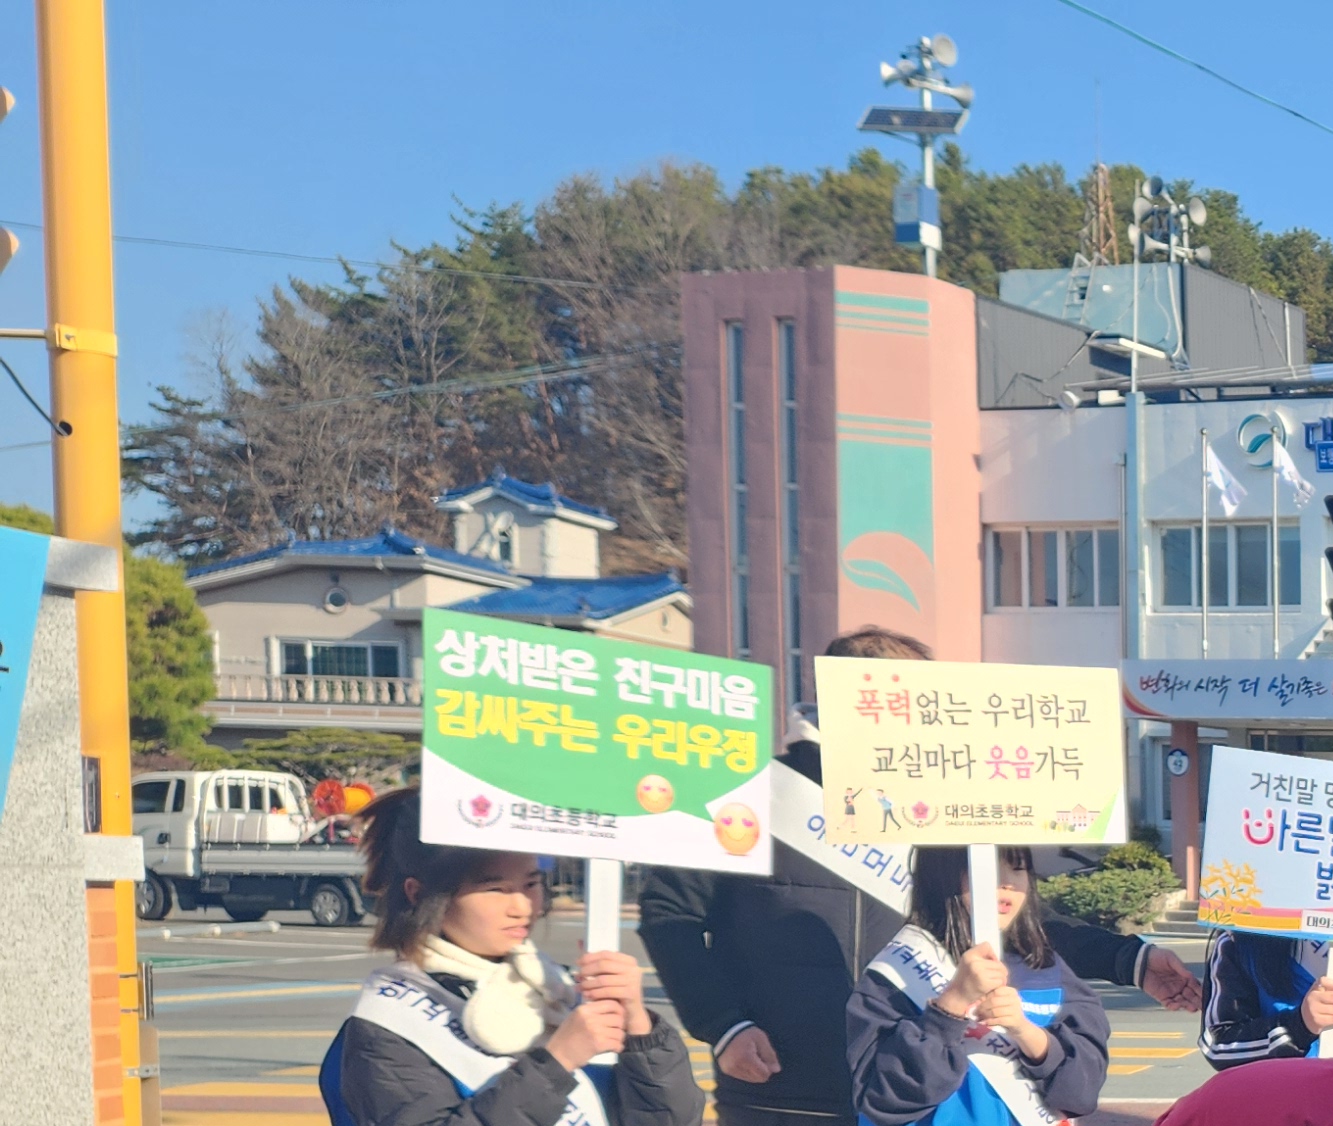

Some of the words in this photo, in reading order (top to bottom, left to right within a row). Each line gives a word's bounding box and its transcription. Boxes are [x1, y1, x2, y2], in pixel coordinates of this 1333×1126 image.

[434, 629, 599, 696] 상처받은
[613, 656, 758, 720] 친구마음
[1140, 670, 1190, 700] 변화의
[1194, 675, 1232, 706] 시작
[1238, 676, 1260, 697] 더
[855, 688, 972, 726] 폭력없는
[981, 693, 1091, 728] 우리학교
[434, 688, 599, 753] 감싸주는
[612, 713, 757, 773] 우리우정
[872, 743, 976, 780] 교실마다
[984, 745, 1083, 781] 웃음가득
[1250, 772, 1317, 806] 거친말
[511, 802, 618, 829] 대의초등학교
[945, 803, 1035, 820] 대의초등학교
